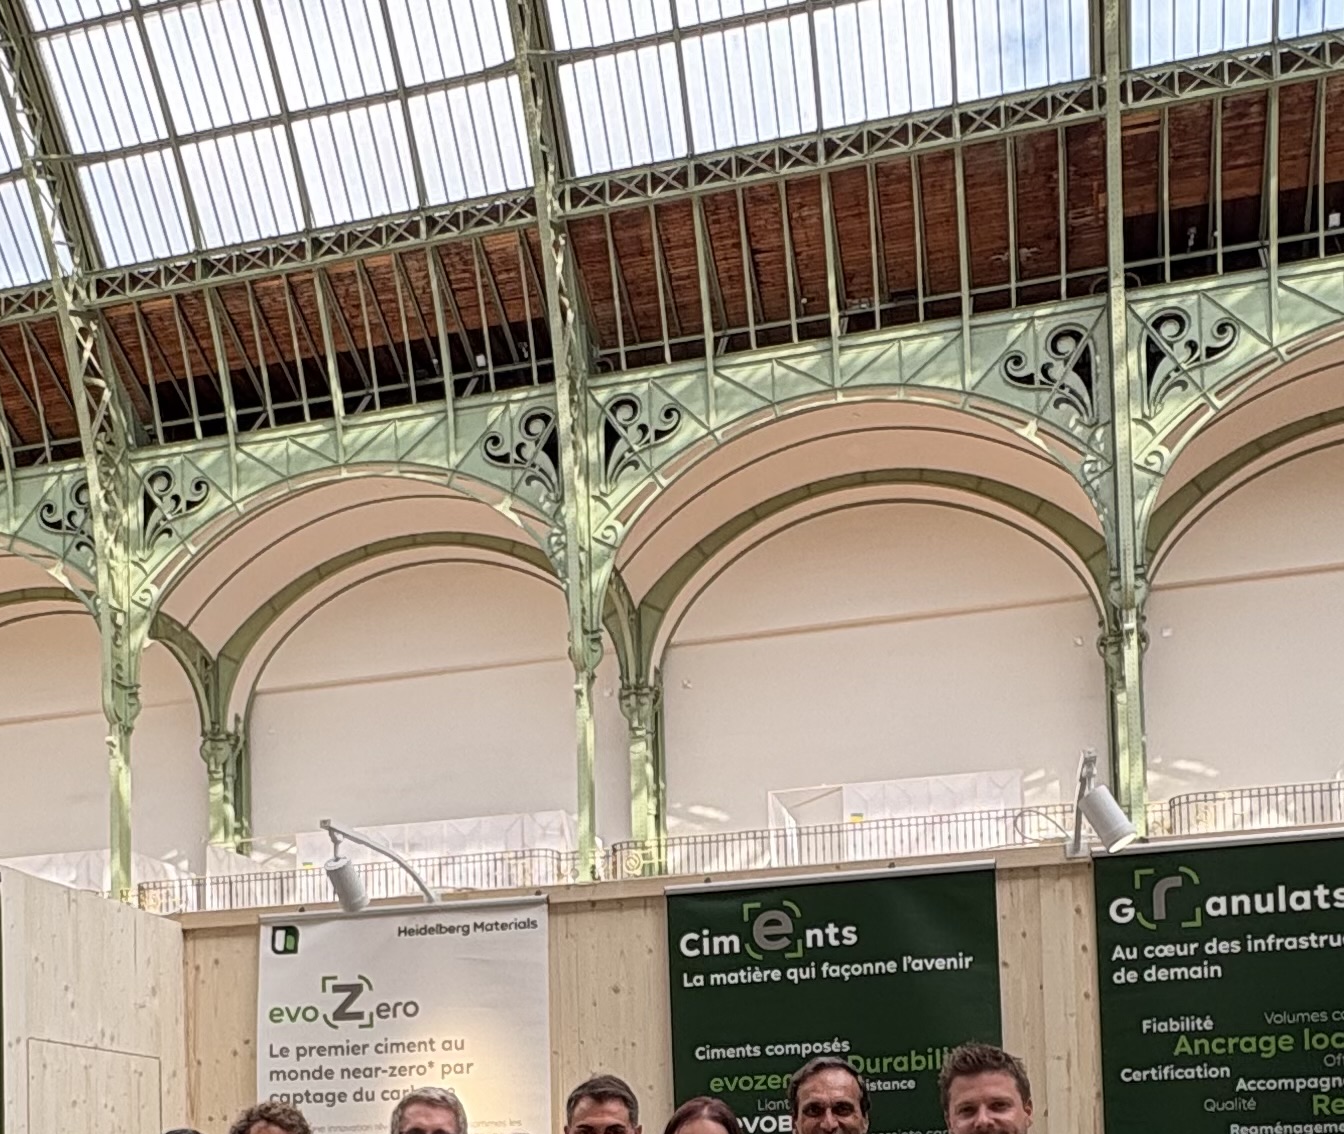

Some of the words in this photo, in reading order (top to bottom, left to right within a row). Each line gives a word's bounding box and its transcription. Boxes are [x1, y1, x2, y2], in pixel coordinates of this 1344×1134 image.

[397, 923, 470, 938] Heidelberg
[473, 918, 538, 934] Materials
[1111, 945, 1138, 961] Au
[1143, 940, 1199, 959] cœur
[1205, 936, 1241, 955] des
[683, 972, 705, 988] La
[710, 964, 782, 986] matière
[786, 964, 817, 985] qui
[821, 958, 898, 982] façonne
[902, 951, 974, 972] l'avenir
[1112, 966, 1138, 985] de
[1143, 960, 1222, 983] demain
[1142, 1014, 1214, 1034] Fiabilité
[1263, 1010, 1328, 1025] Volumes
[269, 1043, 290, 1059] Le
[295, 1040, 370, 1062] premier
[374, 1037, 436, 1055] ciment
[441, 1036, 466, 1051] au
[695, 1042, 762, 1061] Ciments
[766, 1036, 851, 1058] composés
[1173, 1032, 1295, 1058] Ancrage
[269, 1064, 335, 1082] monde
[441, 1061, 474, 1080] par
[1120, 1064, 1231, 1083] Certification
[710, 1073, 793, 1093] evozer
[269, 1088, 348, 1107] captage
[352, 1086, 376, 1103] du
[1203, 1096, 1257, 1113] Qualité
